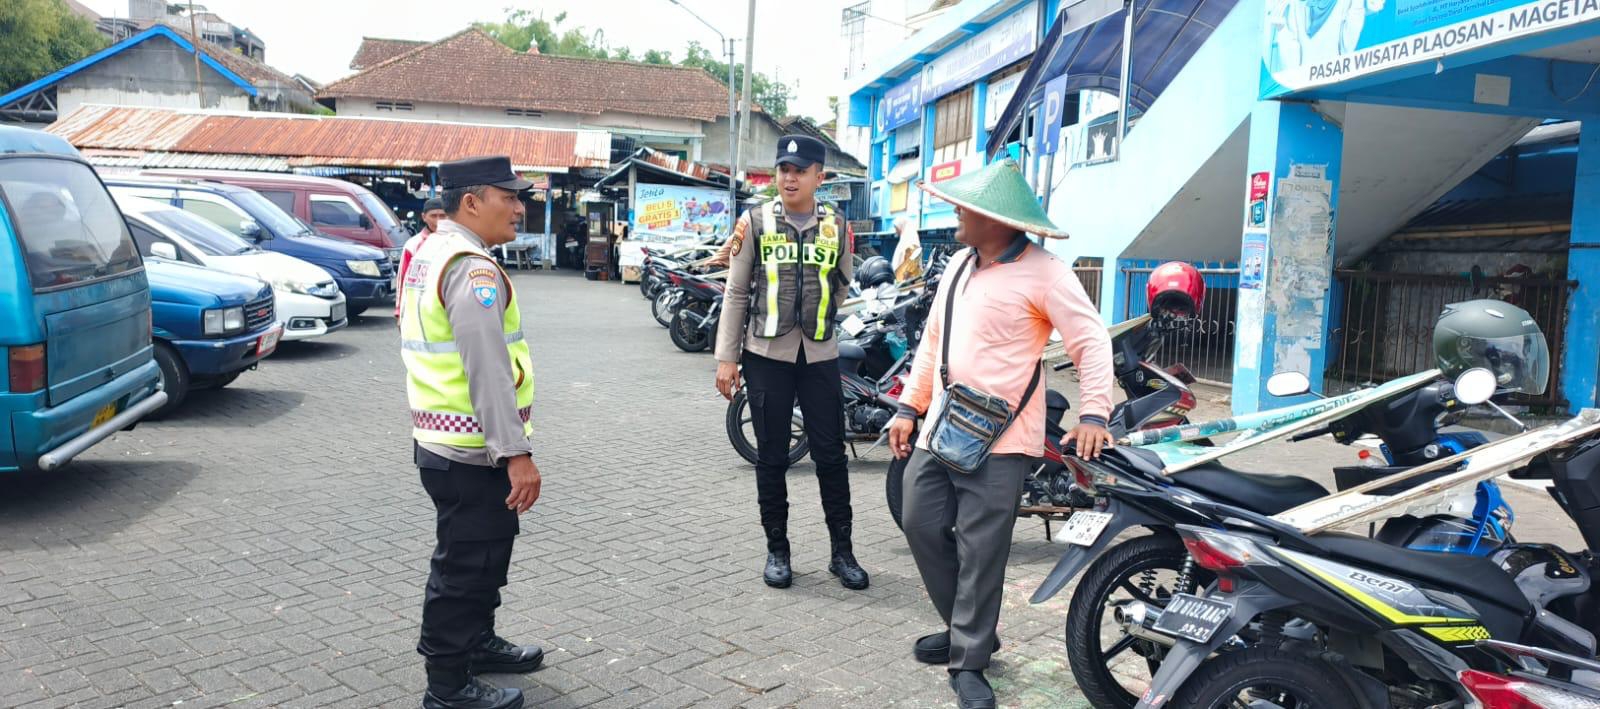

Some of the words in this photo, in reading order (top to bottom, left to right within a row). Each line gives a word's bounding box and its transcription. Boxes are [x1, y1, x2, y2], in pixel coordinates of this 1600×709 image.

[1309, 57, 1351, 80] PASAR
[1354, 41, 1409, 70] WISATA
[1412, 17, 1494, 55] PLAOSAN
[1509, 0, 1600, 31] MAGETA
[1042, 90, 1060, 144] P
[763, 244, 837, 265] POLISI
